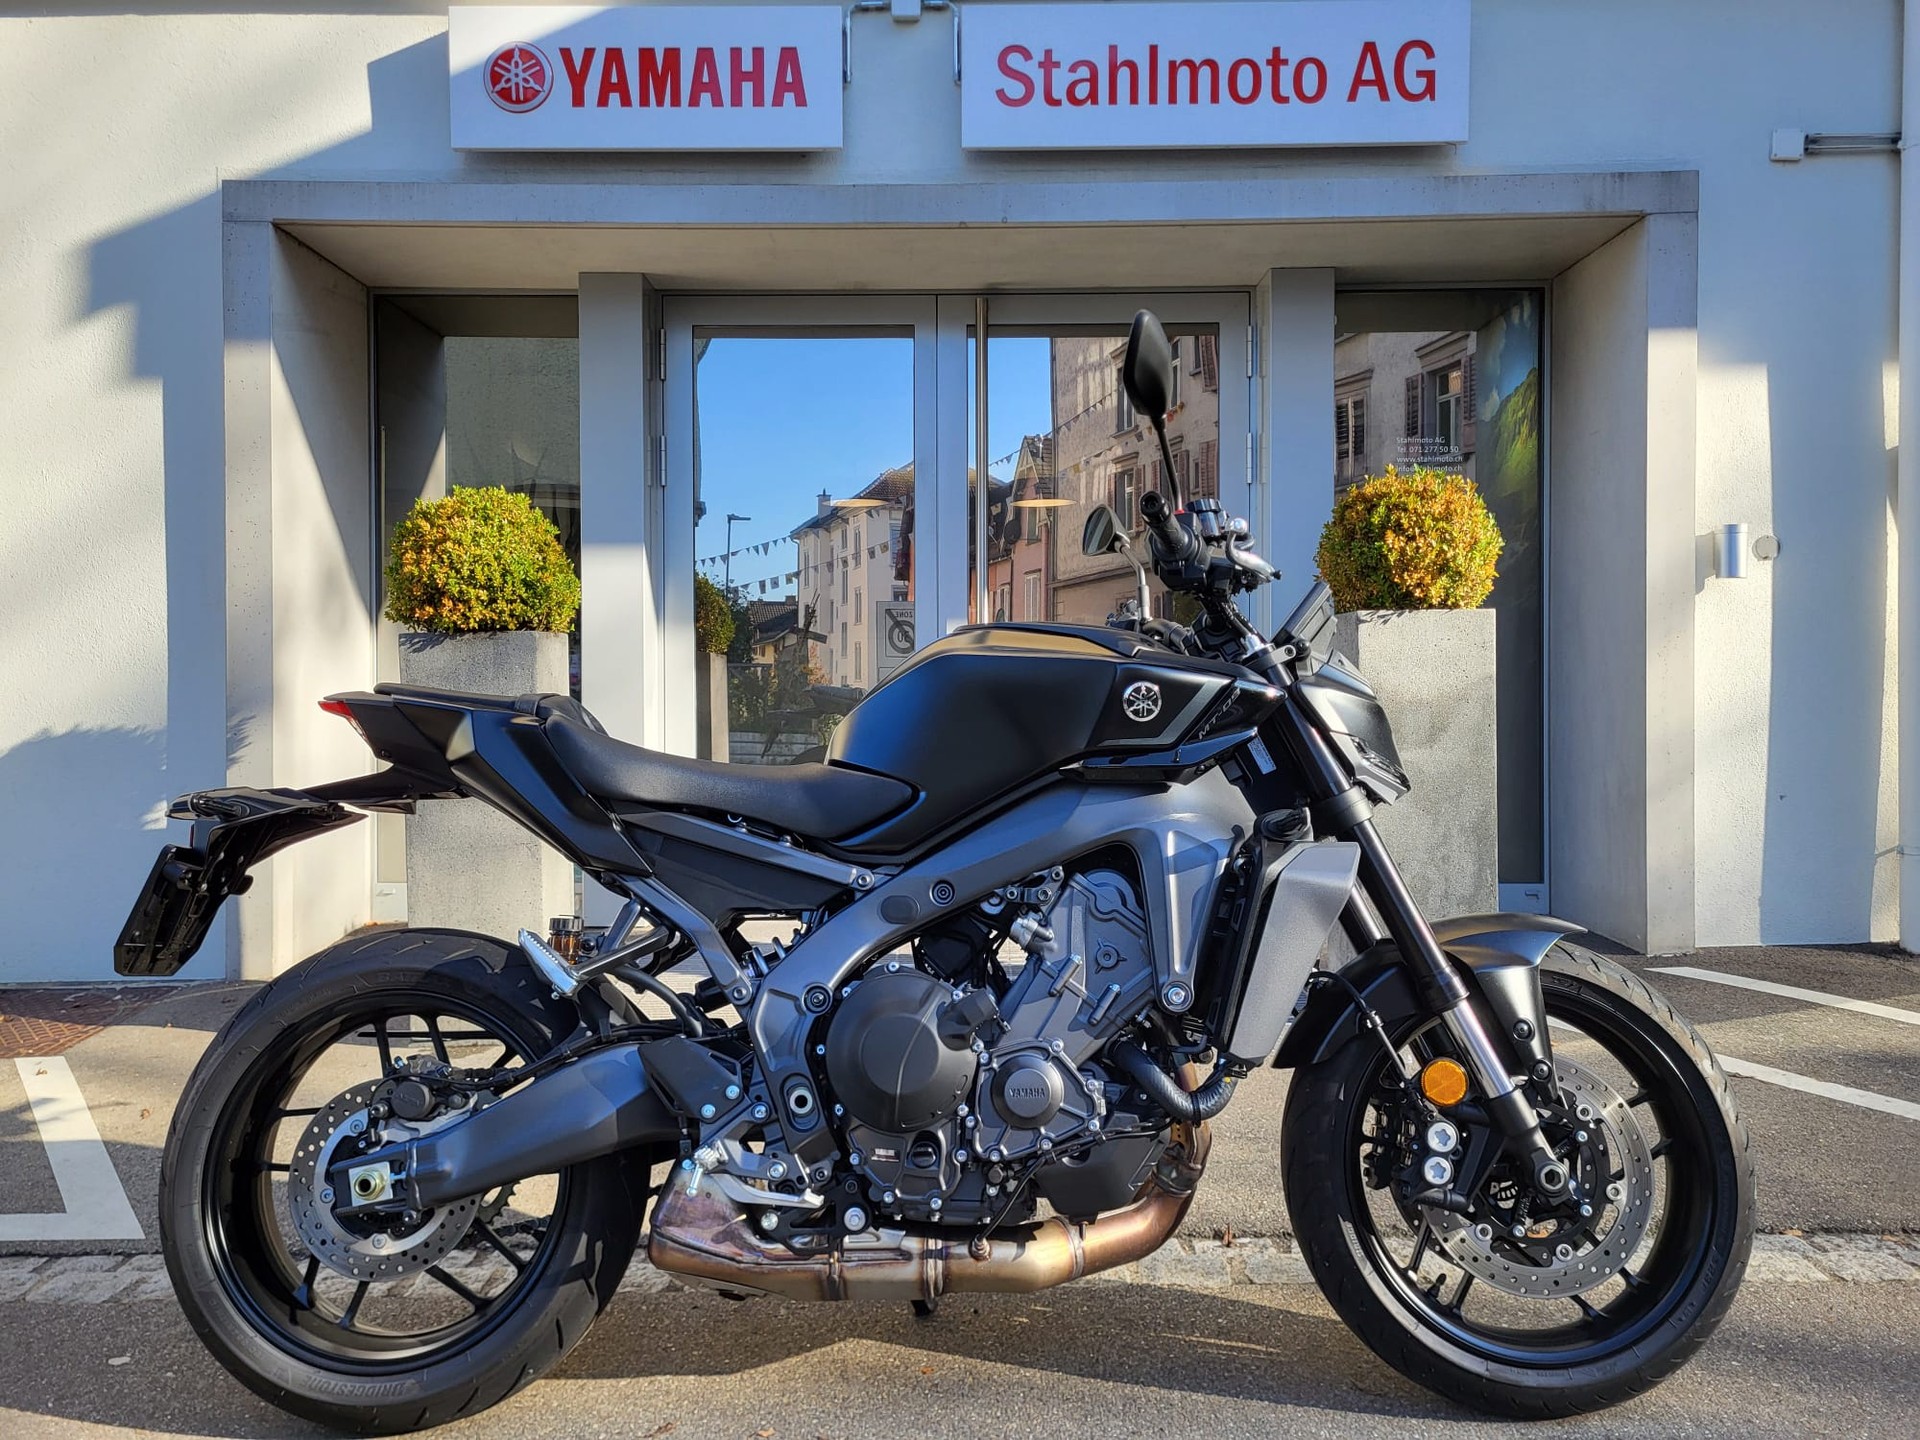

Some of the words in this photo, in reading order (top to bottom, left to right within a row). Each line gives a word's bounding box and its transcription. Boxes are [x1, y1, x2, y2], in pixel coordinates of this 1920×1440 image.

[558, 47, 807, 107] YAMAHA
[995, 44, 1328, 107] Stahlmoto
[1346, 39, 1437, 102] AG
[1396, 436, 1433, 444] Stahlmoto
[1434, 436, 1446, 444] AG
[1396, 455, 1463, 463] www.stahlmoto.ch
[1009, 1087, 1046, 1099] YAMAHA
